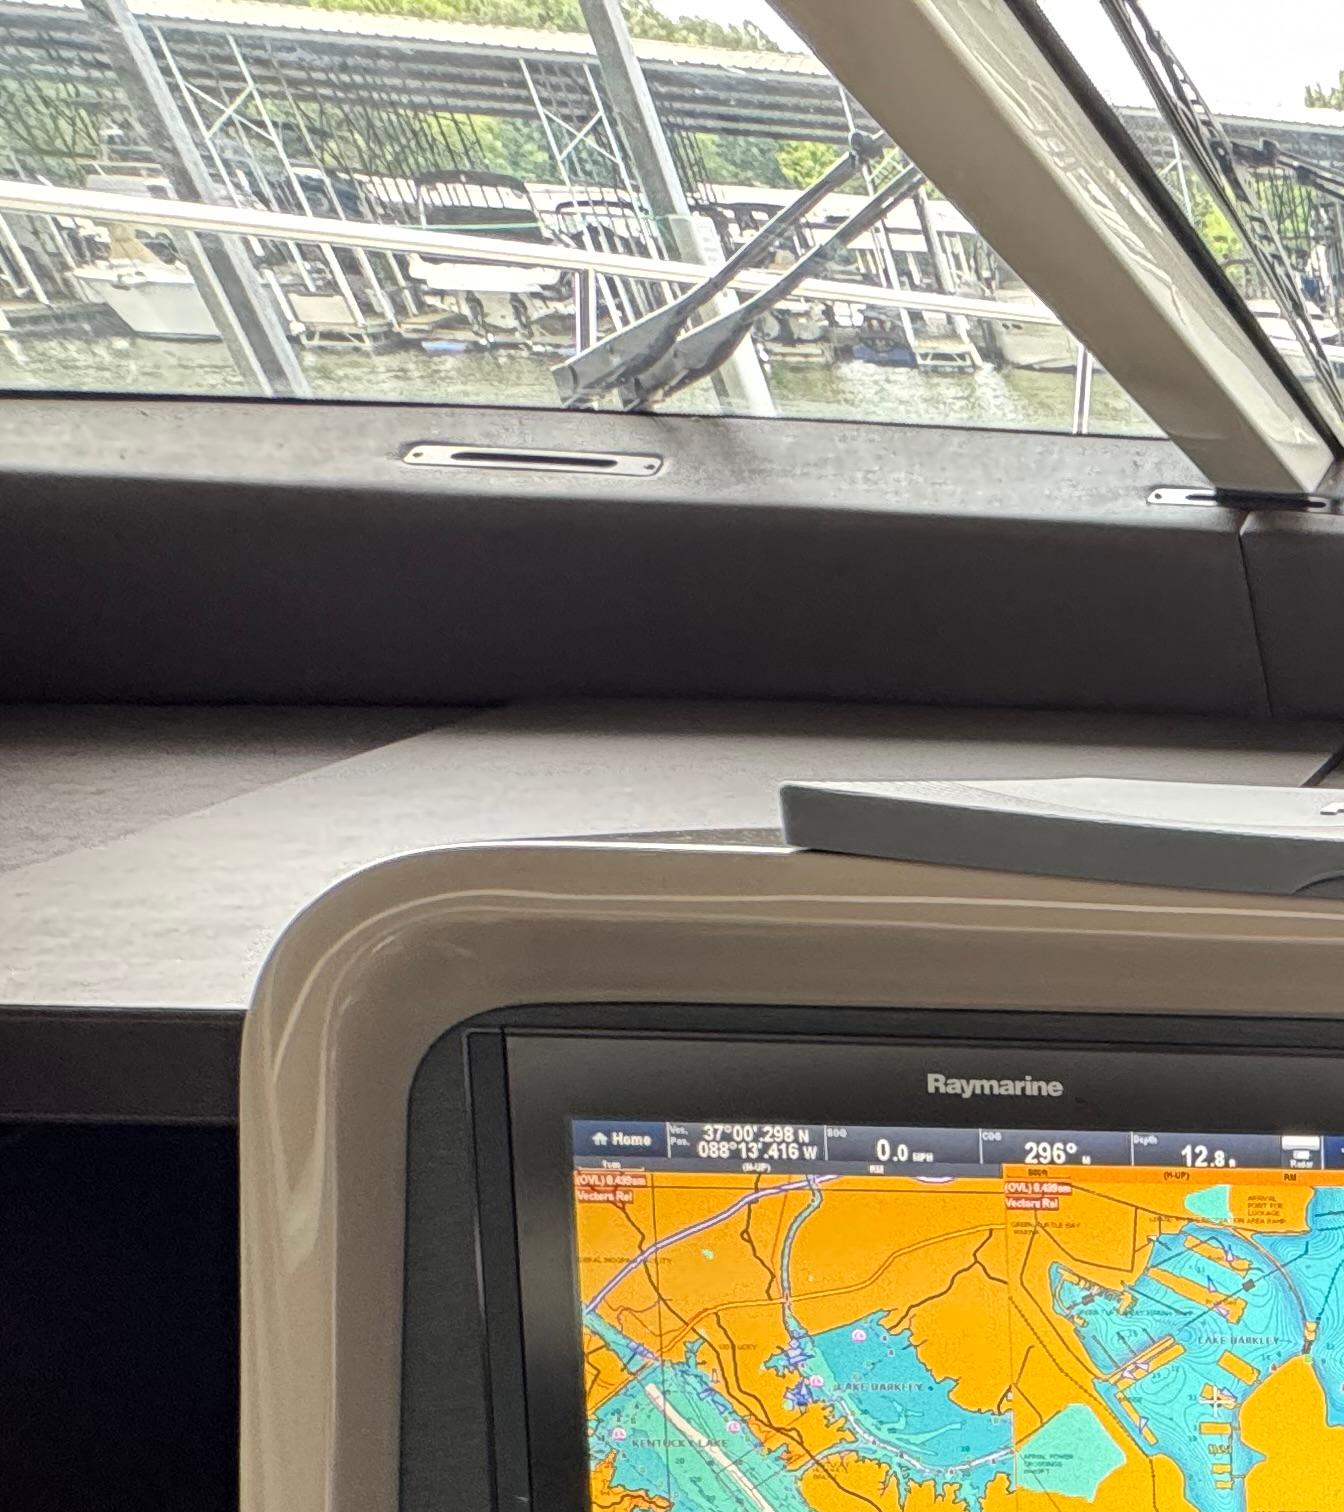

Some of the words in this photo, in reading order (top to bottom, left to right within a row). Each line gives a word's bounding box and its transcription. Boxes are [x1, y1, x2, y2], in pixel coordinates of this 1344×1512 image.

[927, 1073, 1064, 1098] Raymarine
[611, 1131, 652, 1147] Home
[798, 1129, 809, 1144] N
[1133, 1134, 1158, 1145] Depth
[803, 1145, 818, 1160] W
[876, 1138, 909, 1162] 0.0
[1181, 1144, 1225, 1168] 12.8
[1198, 1335, 1227, 1345] LAKE
[1230, 1335, 1280, 1345] BARKLEY
[632, 1439, 695, 1448] KENTUCKY
